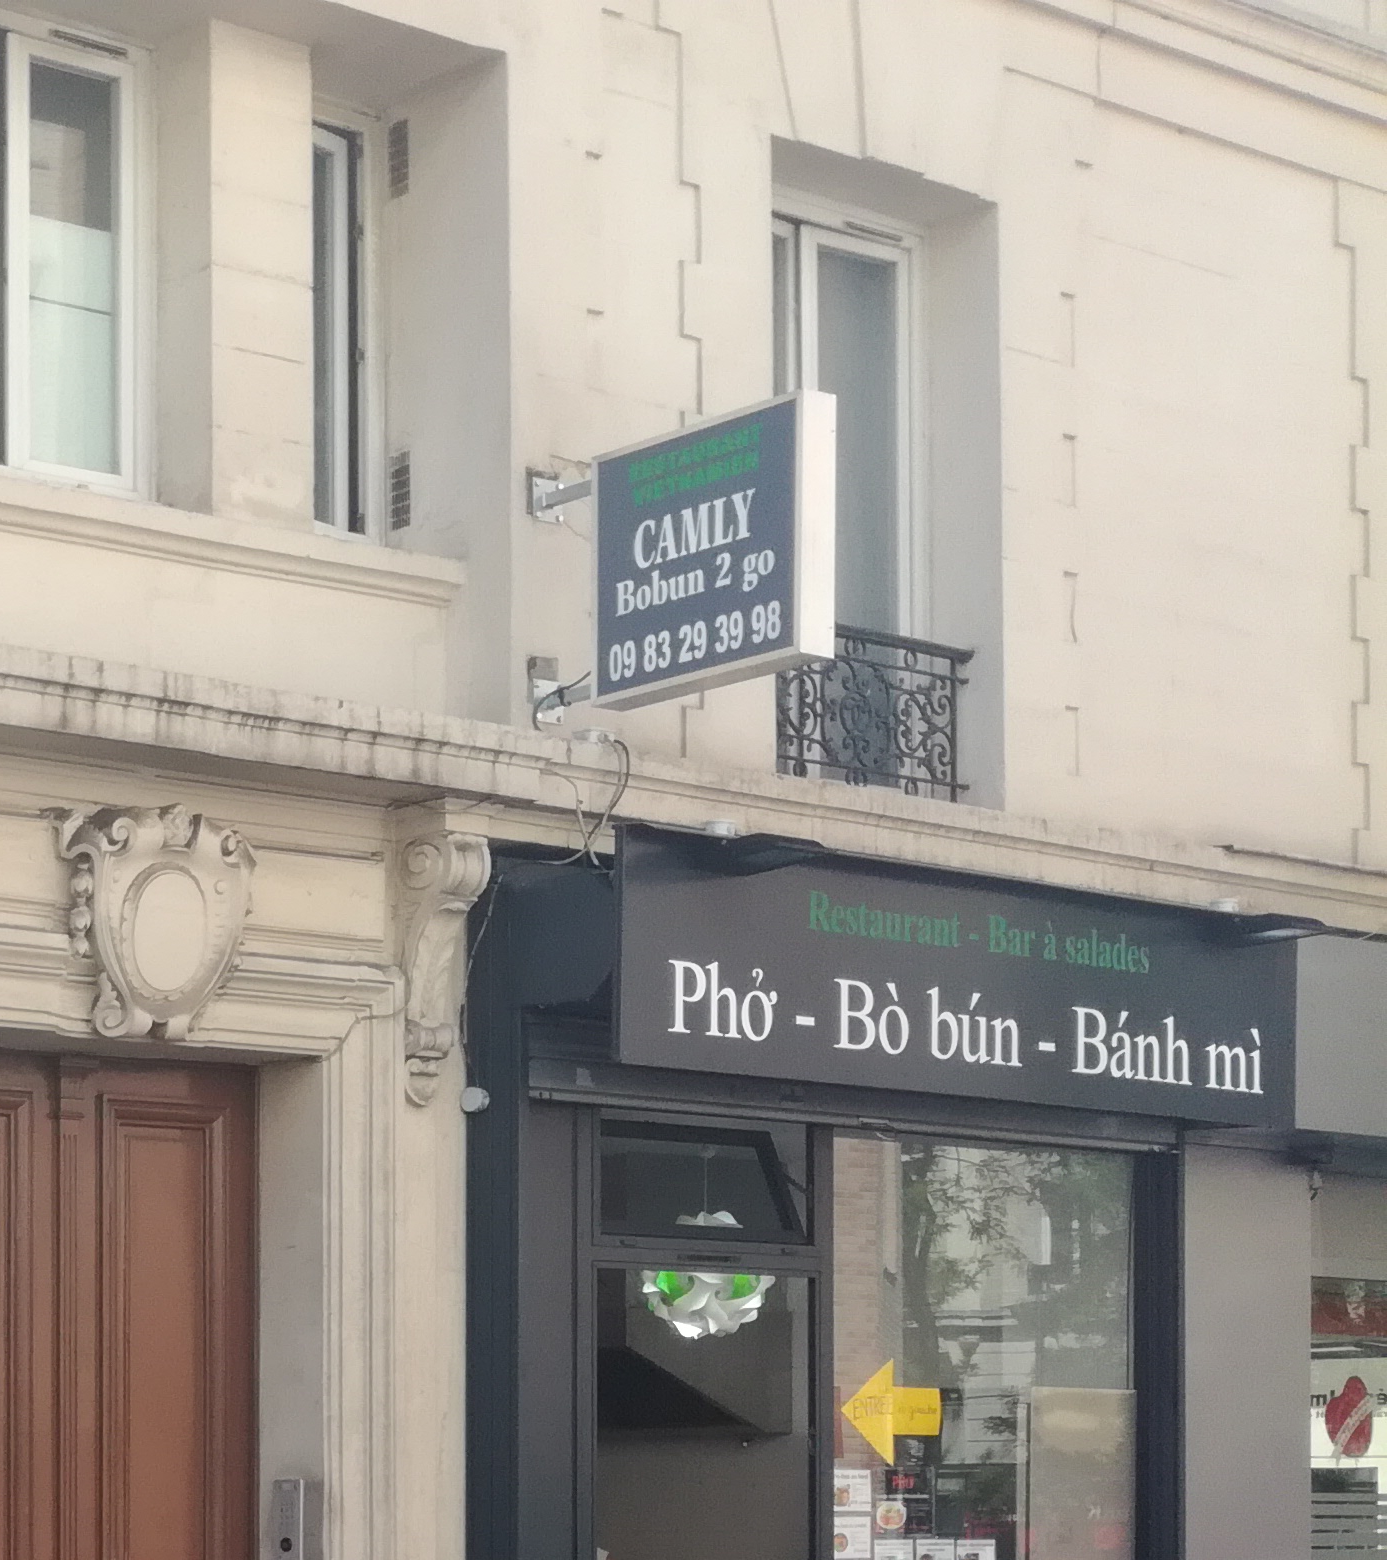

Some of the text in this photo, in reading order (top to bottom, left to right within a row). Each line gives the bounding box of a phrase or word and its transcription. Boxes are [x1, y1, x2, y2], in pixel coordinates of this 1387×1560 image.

[633, 488, 757, 569] CAMLY
[615, 549, 776, 617] Bobun 2 go
[608, 600, 782, 682] 09 83 29 39 98
[808, 889, 961, 949] Restaurant
[988, 914, 1035, 958] Bar
[1042, 921, 1058, 960] à
[1064, 928, 1151, 975] salades
[668, 959, 778, 1042] Phở
[834, 977, 910, 1055] Bò
[926, 986, 1023, 1067] bún
[1071, 1006, 1194, 1086] Bánh
[1205, 1028, 1265, 1096] mì
